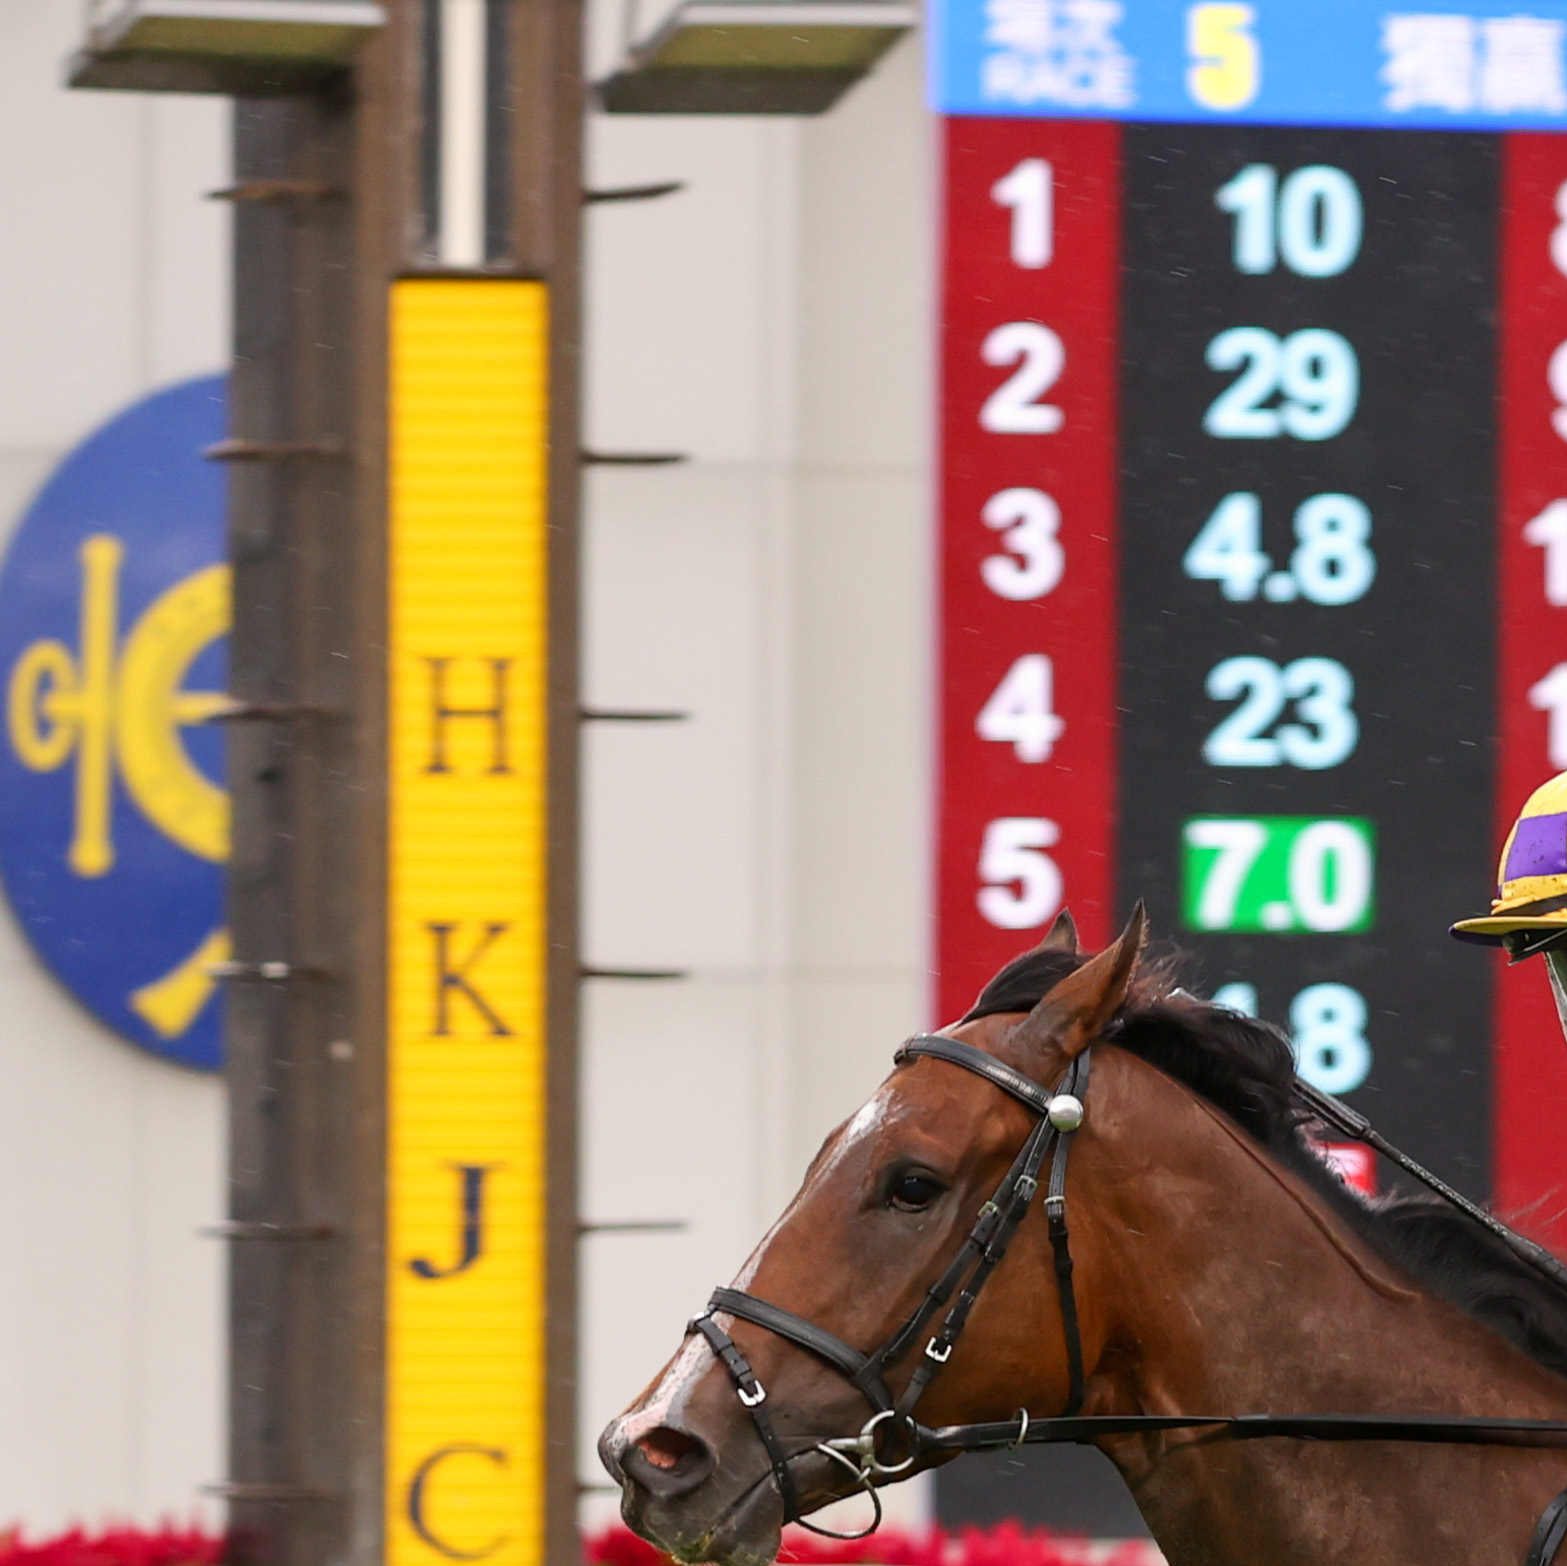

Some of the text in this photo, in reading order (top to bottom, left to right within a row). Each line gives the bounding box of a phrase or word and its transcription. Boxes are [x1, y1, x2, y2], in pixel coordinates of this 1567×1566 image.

[1187, 3, 1260, 111] 5
[993, 158, 1053, 269] 1
[1216, 164, 1362, 277] 10
[980, 322, 1064, 434] 2
[1204, 326, 1358, 440] 29
[982, 487, 1064, 600] 3
[1184, 492, 1375, 605] 4.8
[978, 654, 1062, 763] 4
[1204, 656, 1357, 769] 23
[977, 817, 1061, 929] 5
[1187, 820, 1371, 932] 7.0
